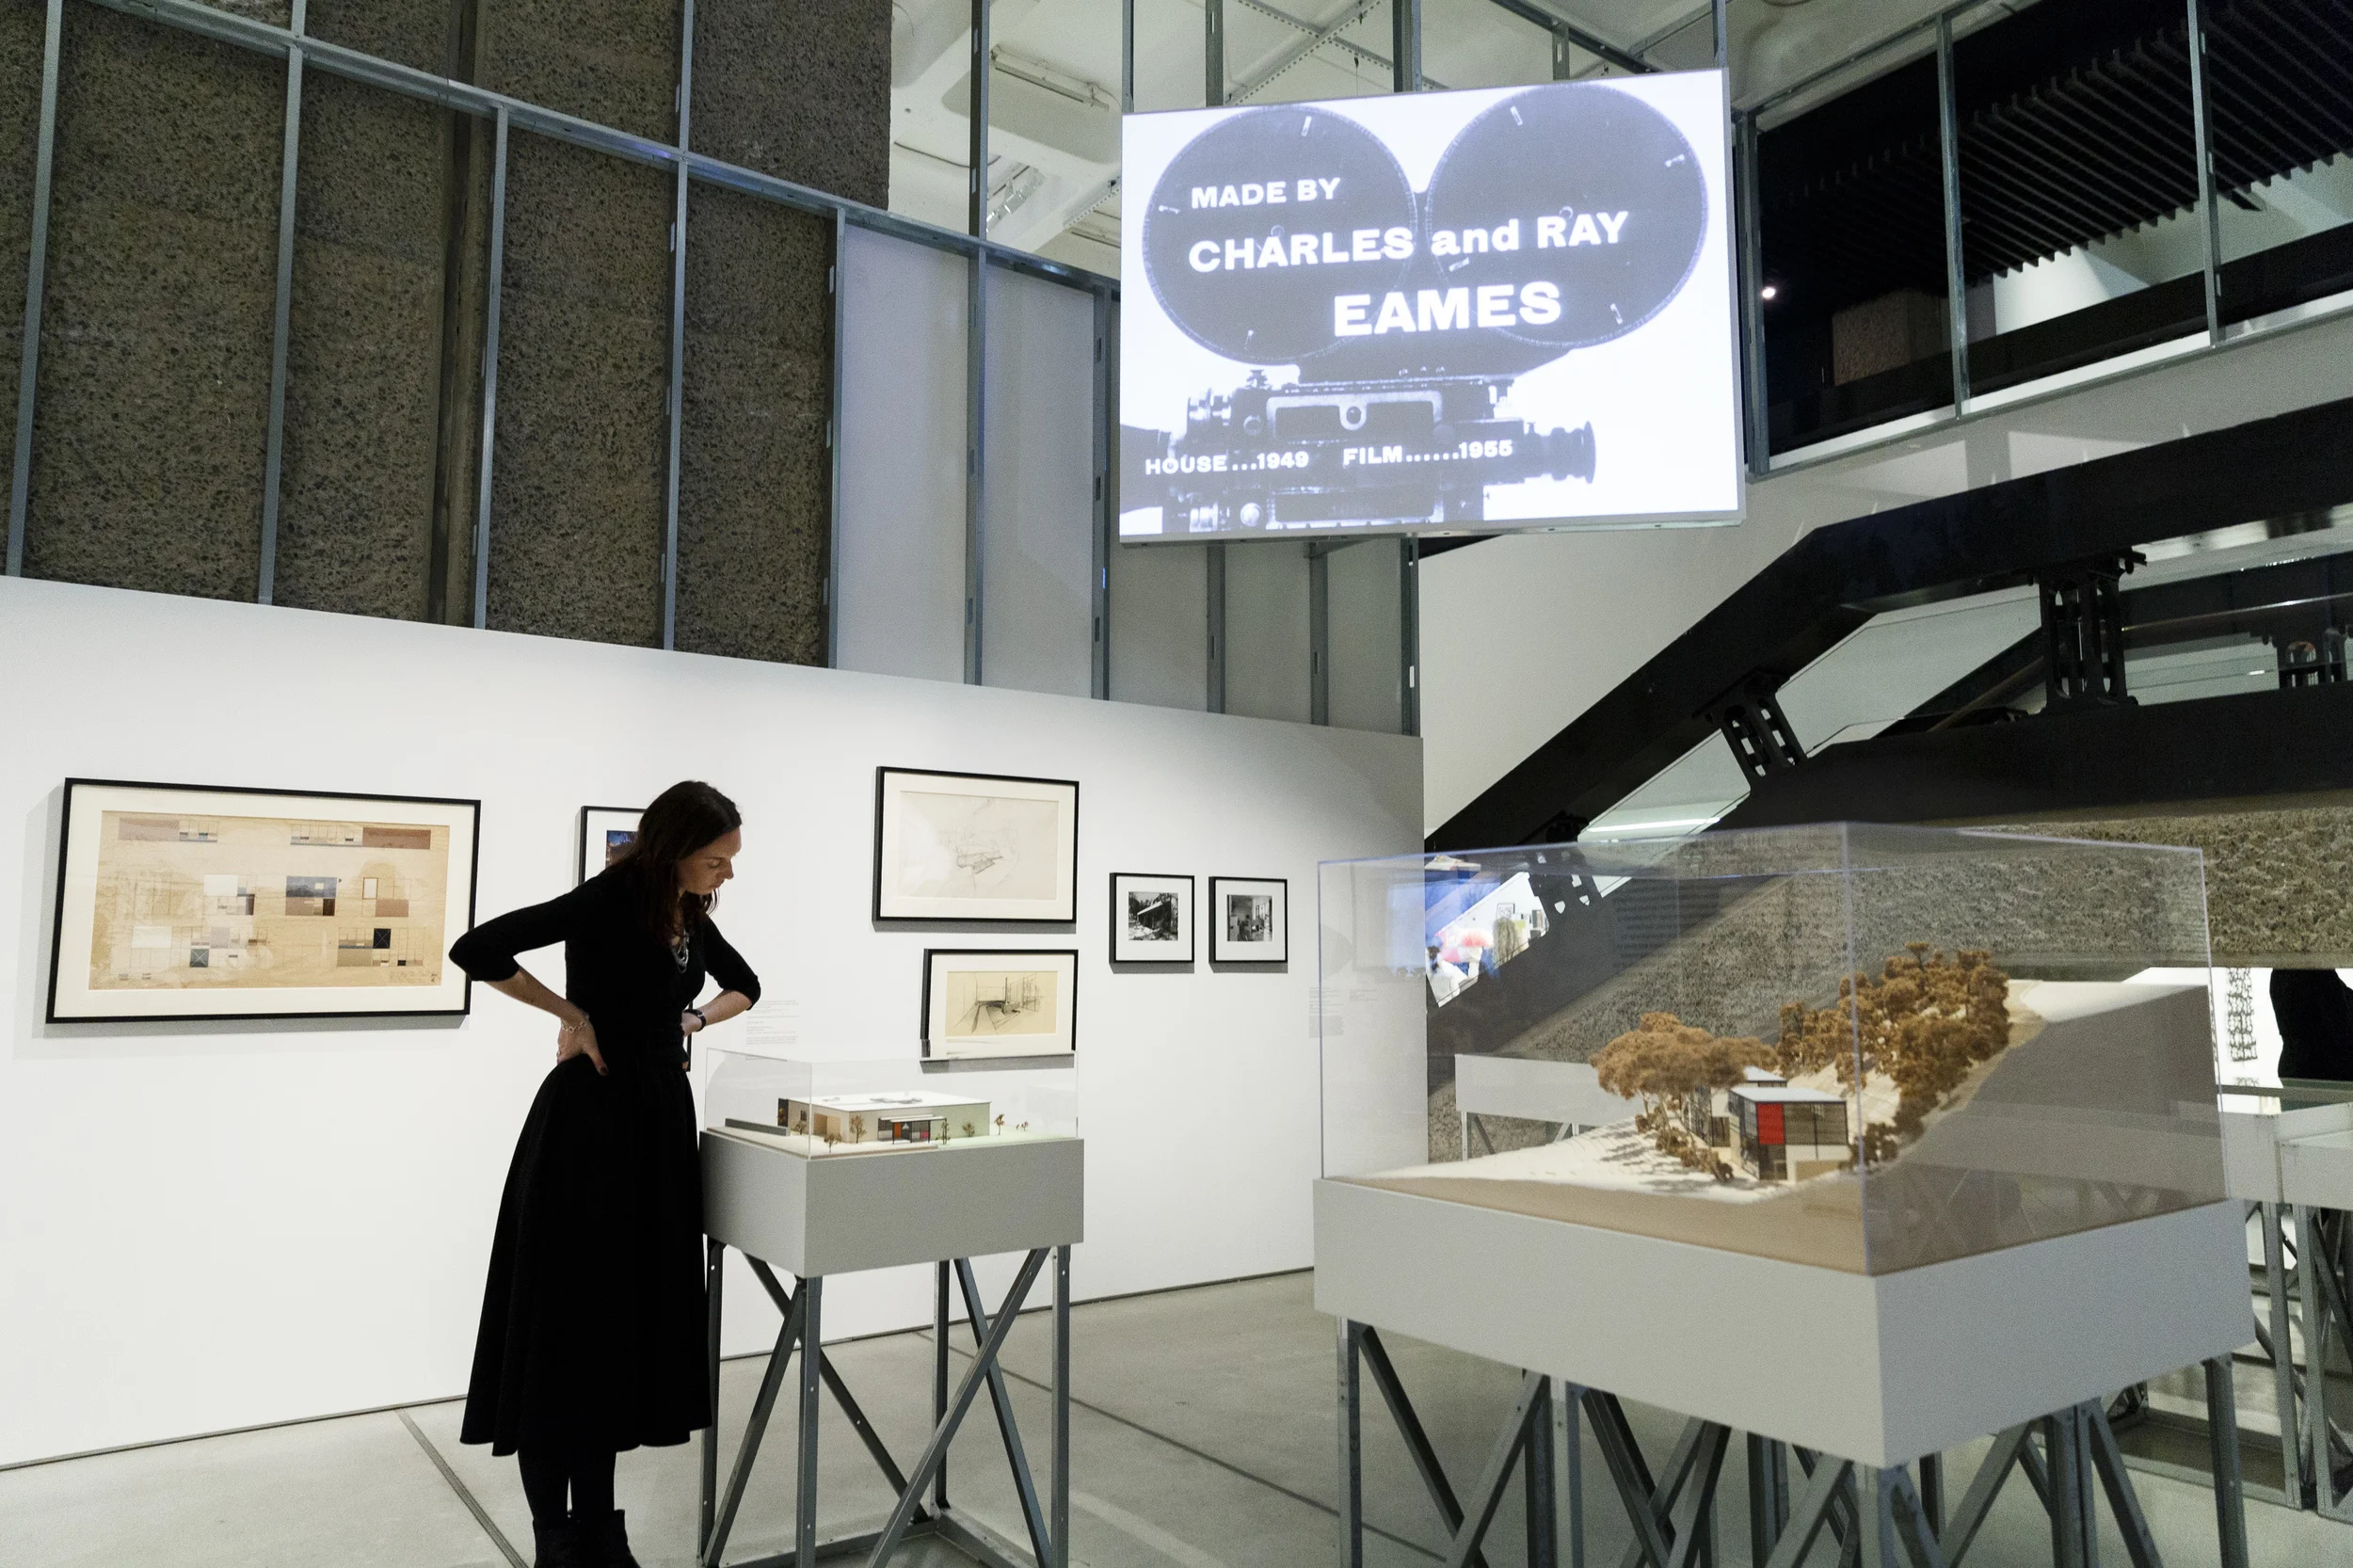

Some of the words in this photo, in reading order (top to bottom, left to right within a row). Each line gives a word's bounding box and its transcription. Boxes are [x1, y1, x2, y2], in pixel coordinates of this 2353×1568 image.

[1191, 181, 1287, 209] MADE
[1297, 177, 1341, 201] BY
[1188, 227, 1416, 273] CHARLES
[1430, 218, 1519, 256] and
[1536, 210, 1629, 248] RAY
[1334, 280, 1561, 337] EAMES
